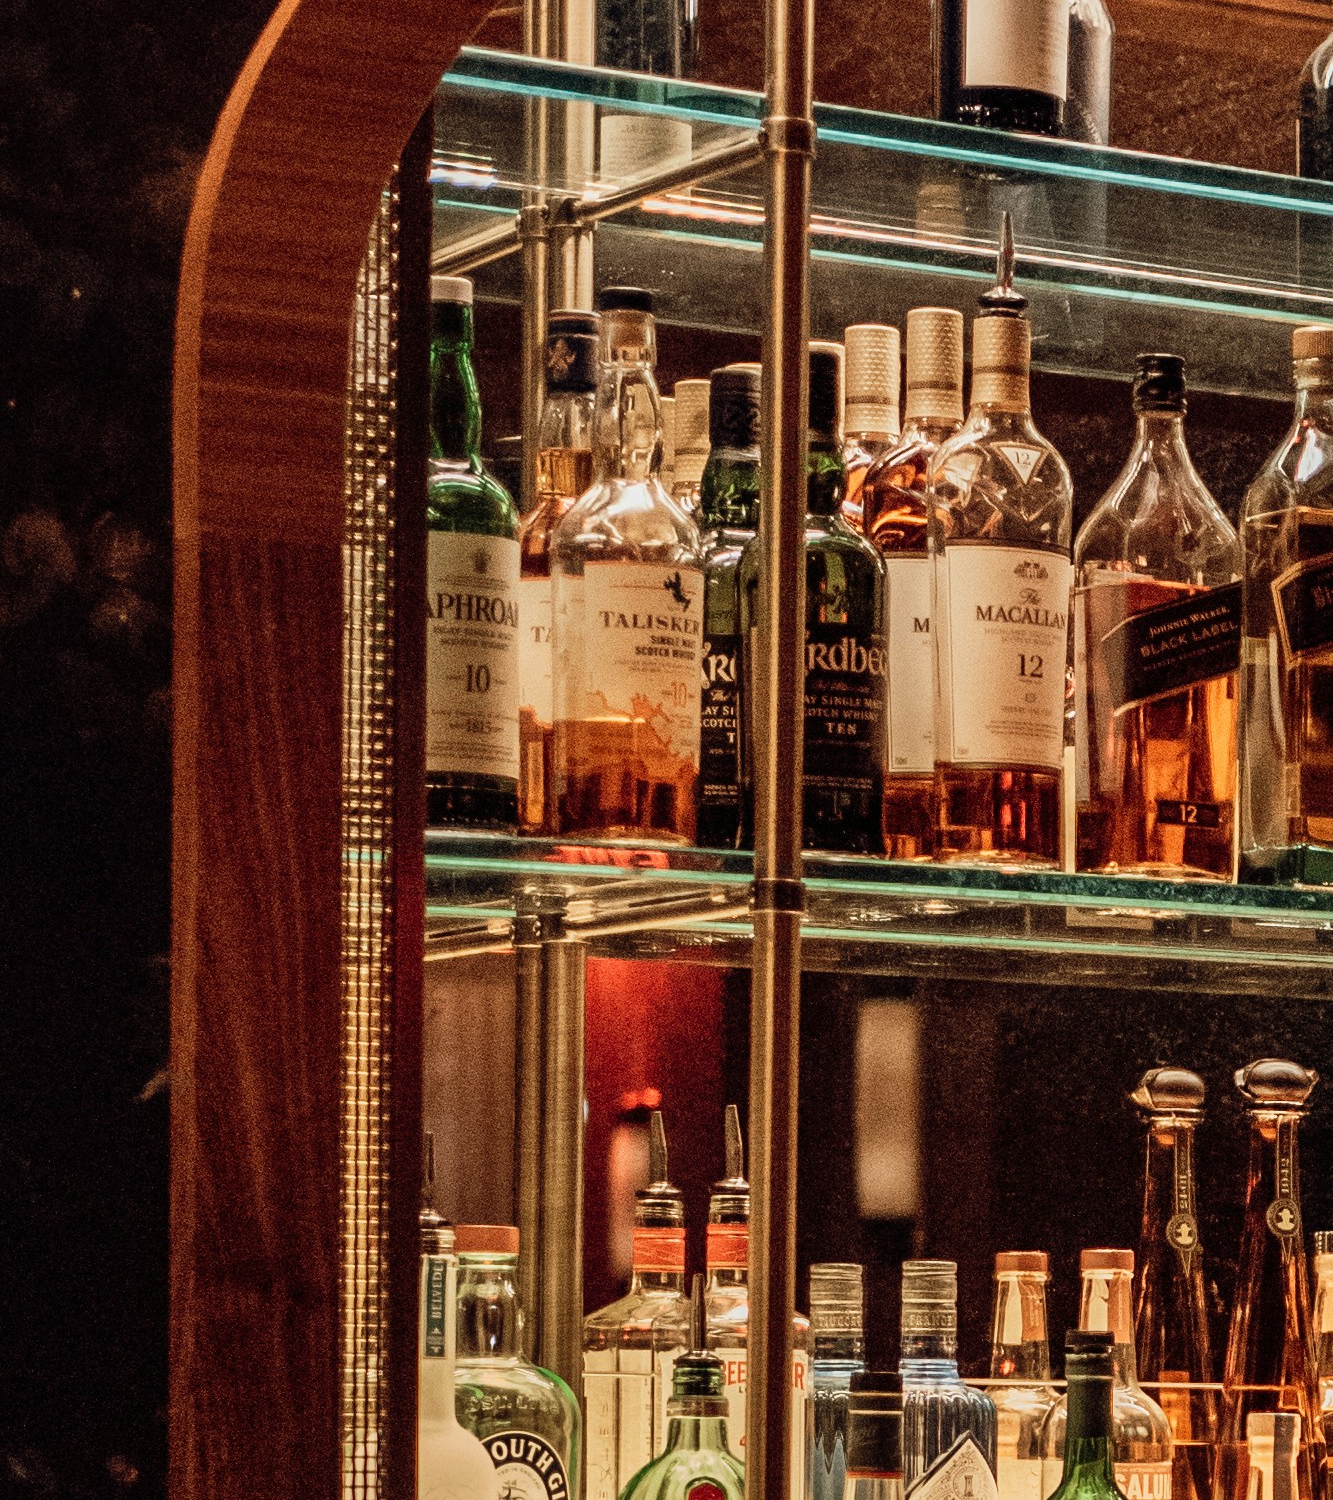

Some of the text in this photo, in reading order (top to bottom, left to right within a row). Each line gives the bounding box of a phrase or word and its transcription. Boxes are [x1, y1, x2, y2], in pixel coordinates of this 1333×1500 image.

[1014, 452, 1031, 467] 12
[599, 611, 700, 637] TALISKER
[1140, 634, 1188, 657] BLACK
[1190, 620, 1239, 644] LABEL
[465, 664, 491, 694] 10
[1017, 653, 1044, 679] 12
[826, 721, 858, 736] TEN
[1181, 804, 1198, 823] 12
